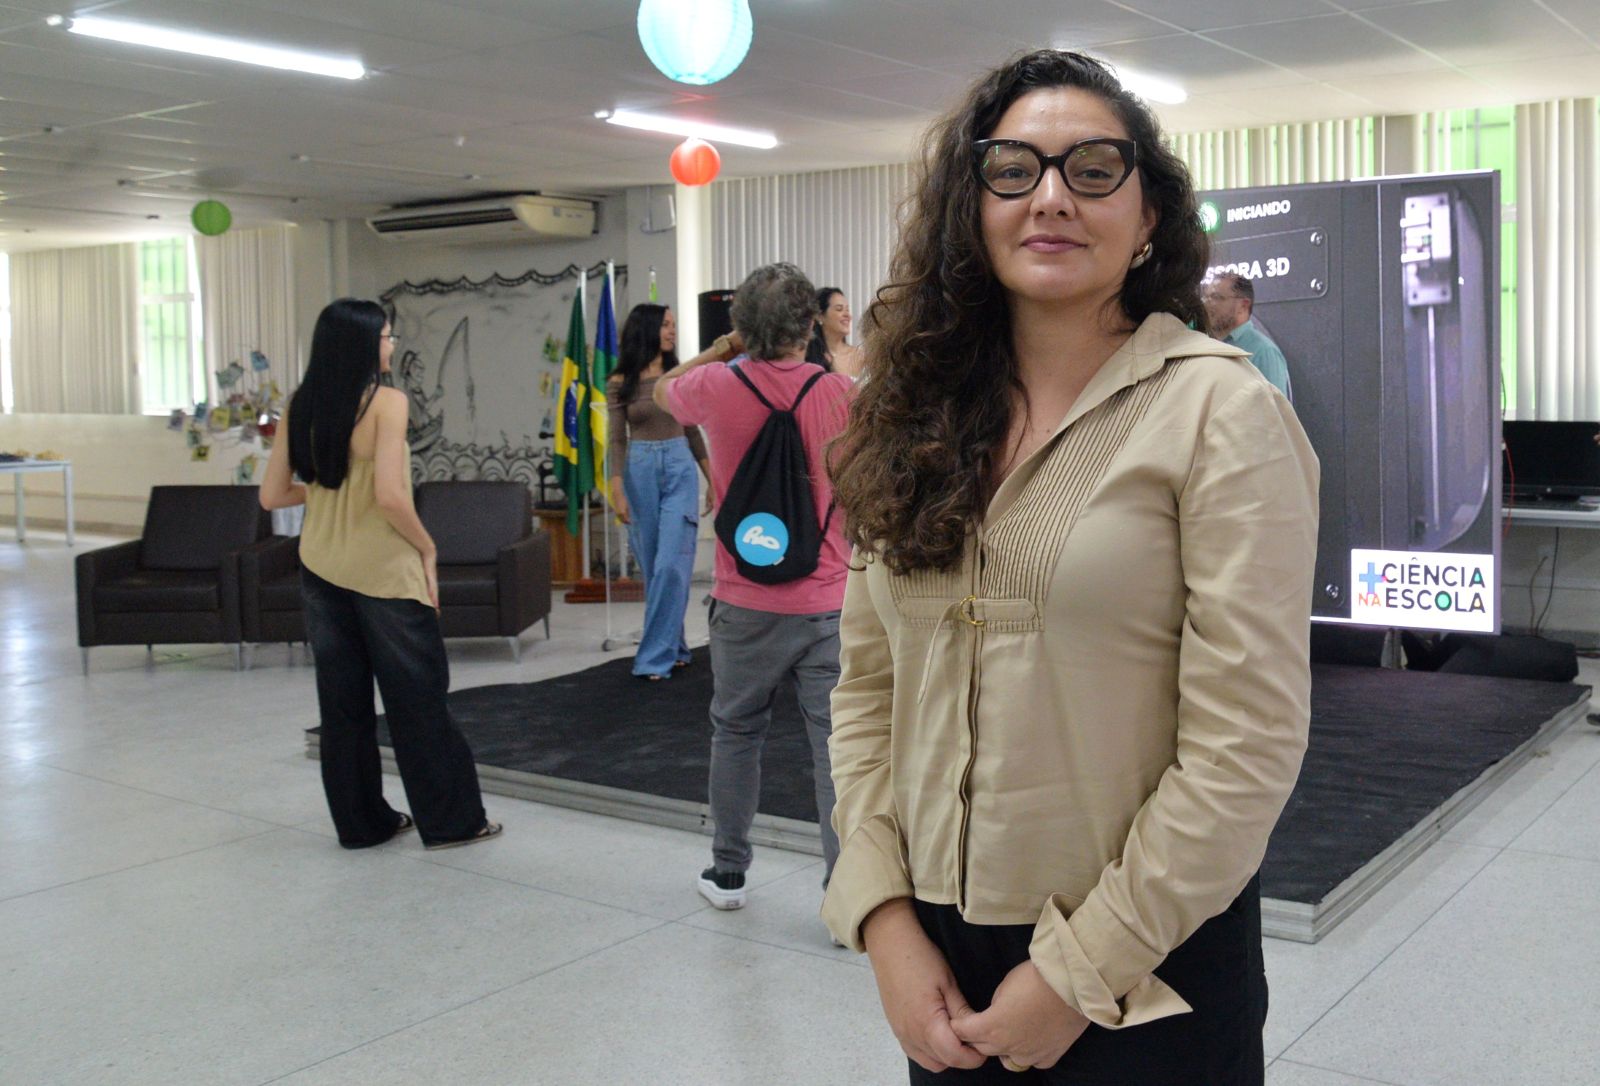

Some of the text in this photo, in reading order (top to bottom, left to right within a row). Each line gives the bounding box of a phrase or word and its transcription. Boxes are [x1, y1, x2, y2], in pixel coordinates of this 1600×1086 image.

[1227, 200, 1291, 222] INICIANDO
[1266, 257, 1290, 277] 3D
[1382, 557, 1485, 588] CIÊNCIA
[1358, 587, 1486, 613] NA ESCOLA
